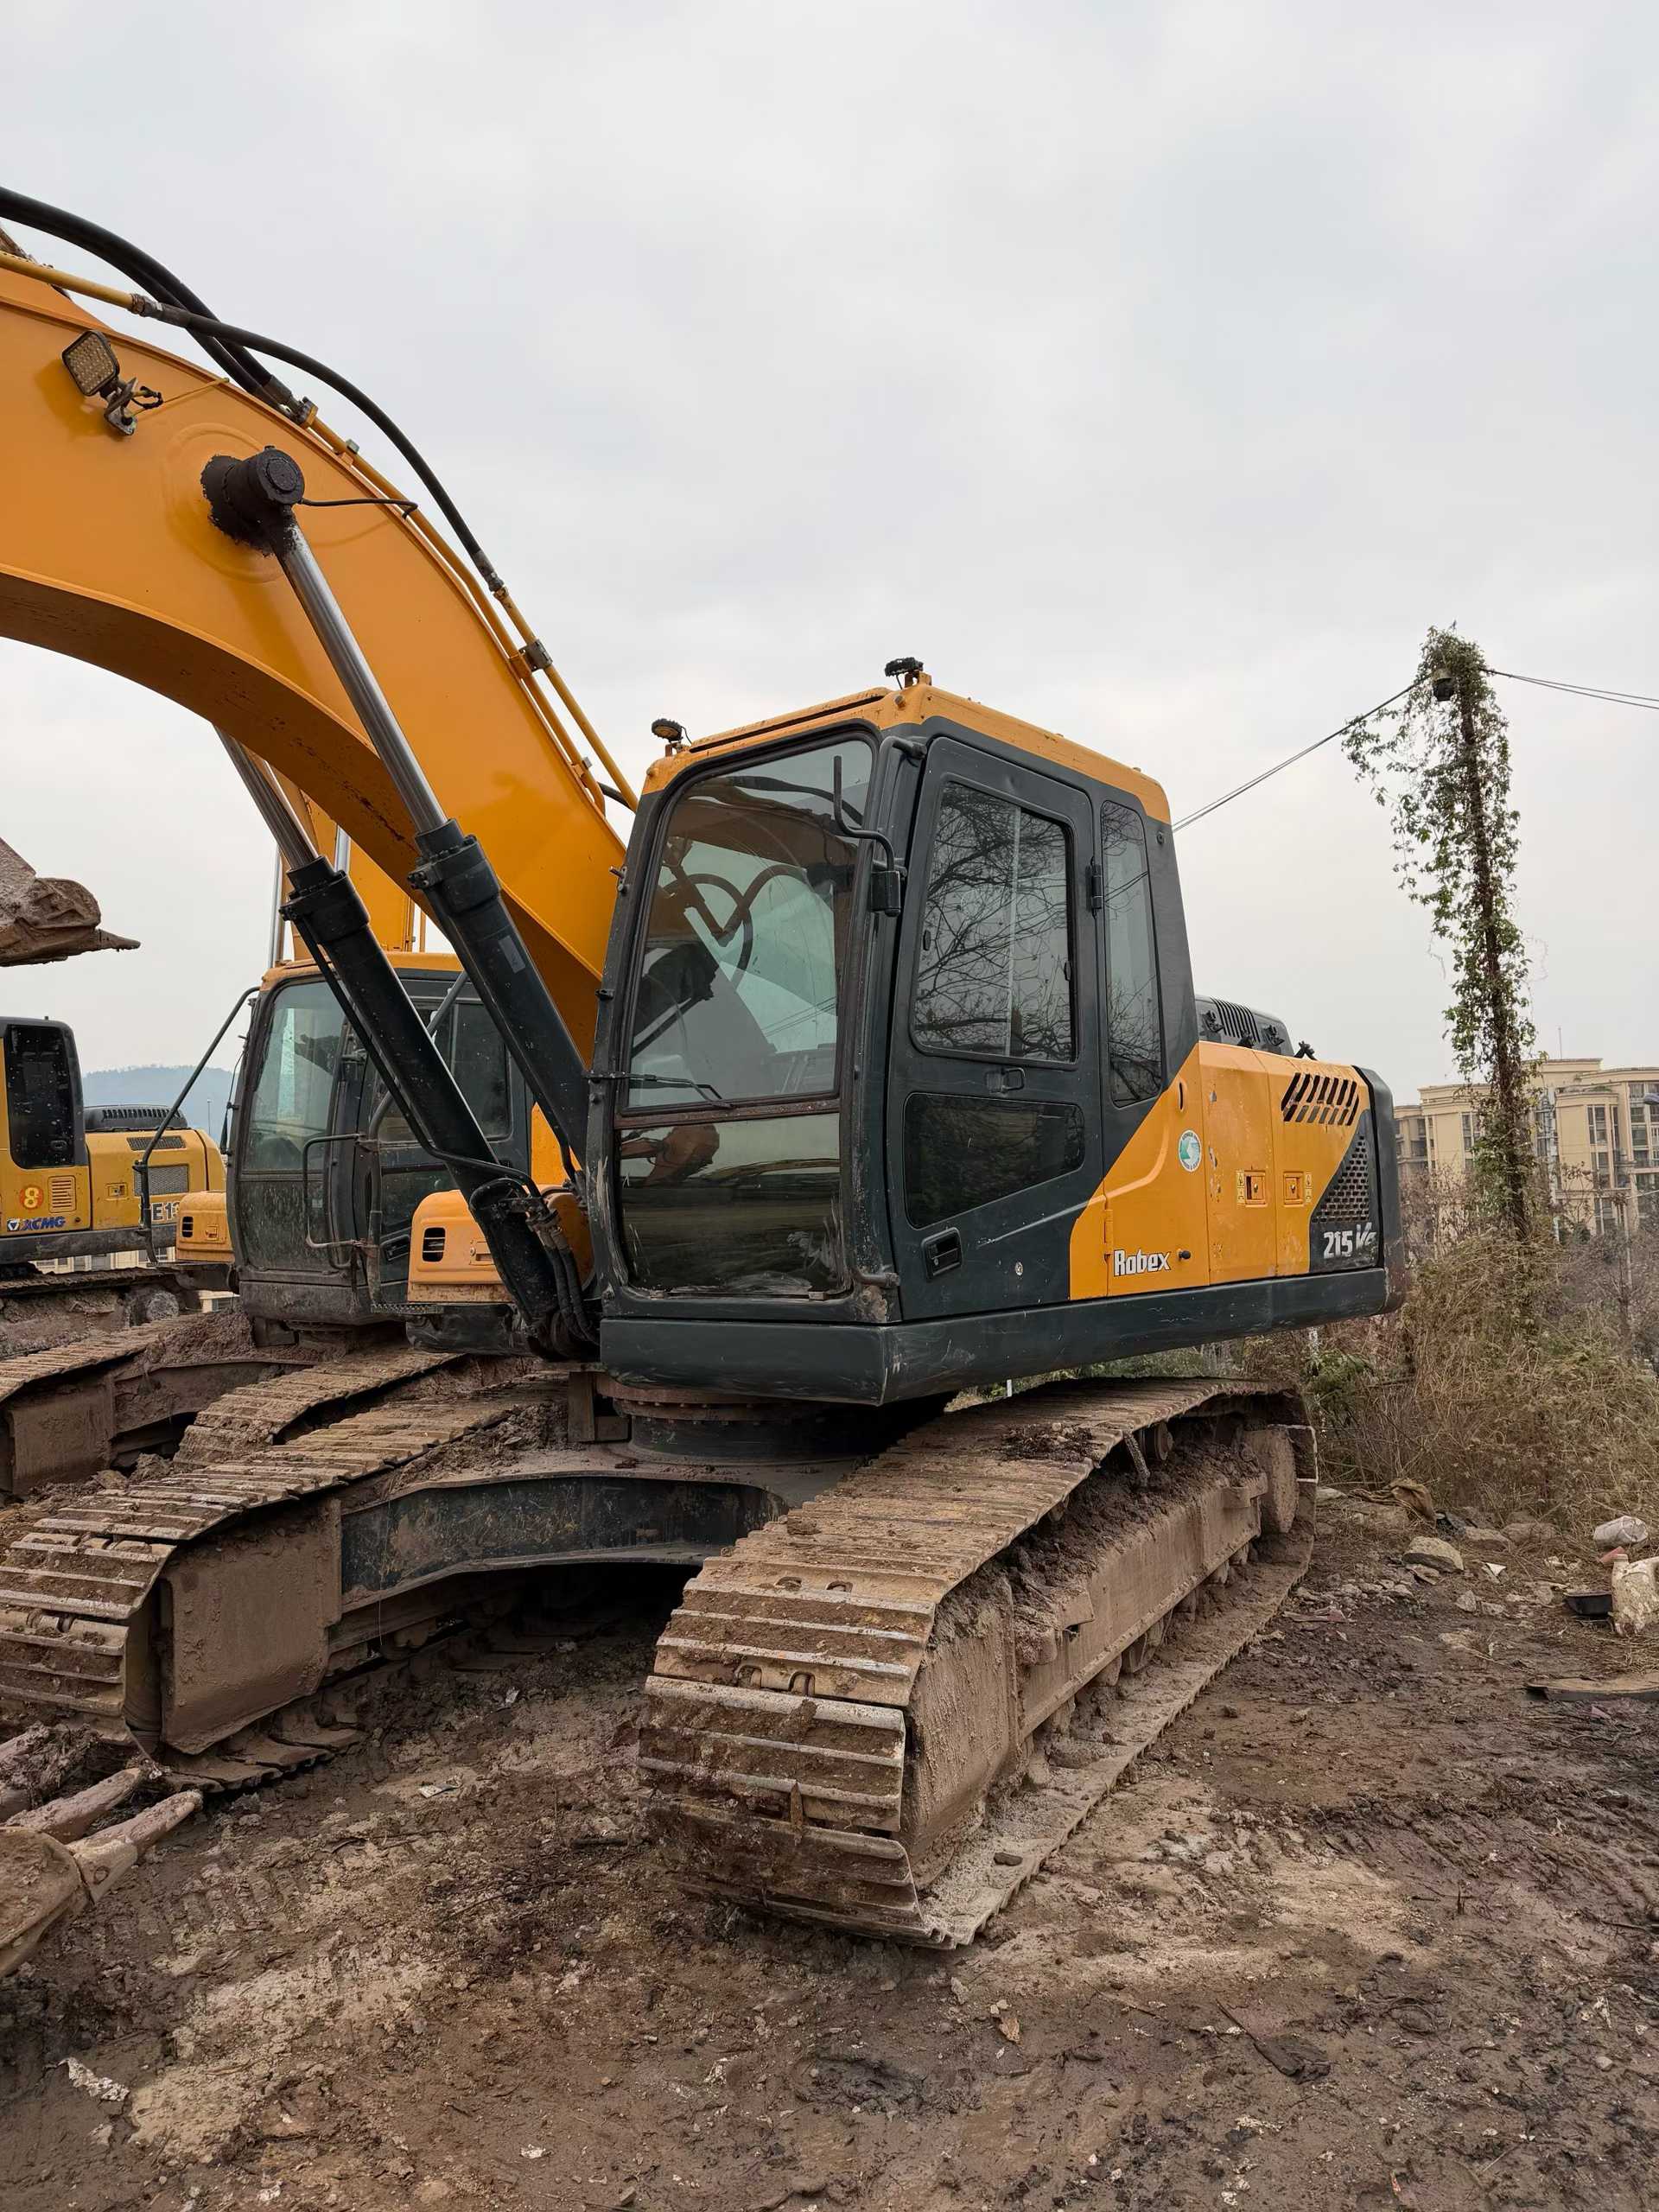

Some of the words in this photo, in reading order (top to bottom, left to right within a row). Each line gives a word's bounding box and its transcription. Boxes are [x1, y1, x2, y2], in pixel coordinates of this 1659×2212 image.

[24, 1187, 39, 1208] 8
[20, 1216, 65, 1230] XCMG
[1114, 1249, 1170, 1276] Robex
